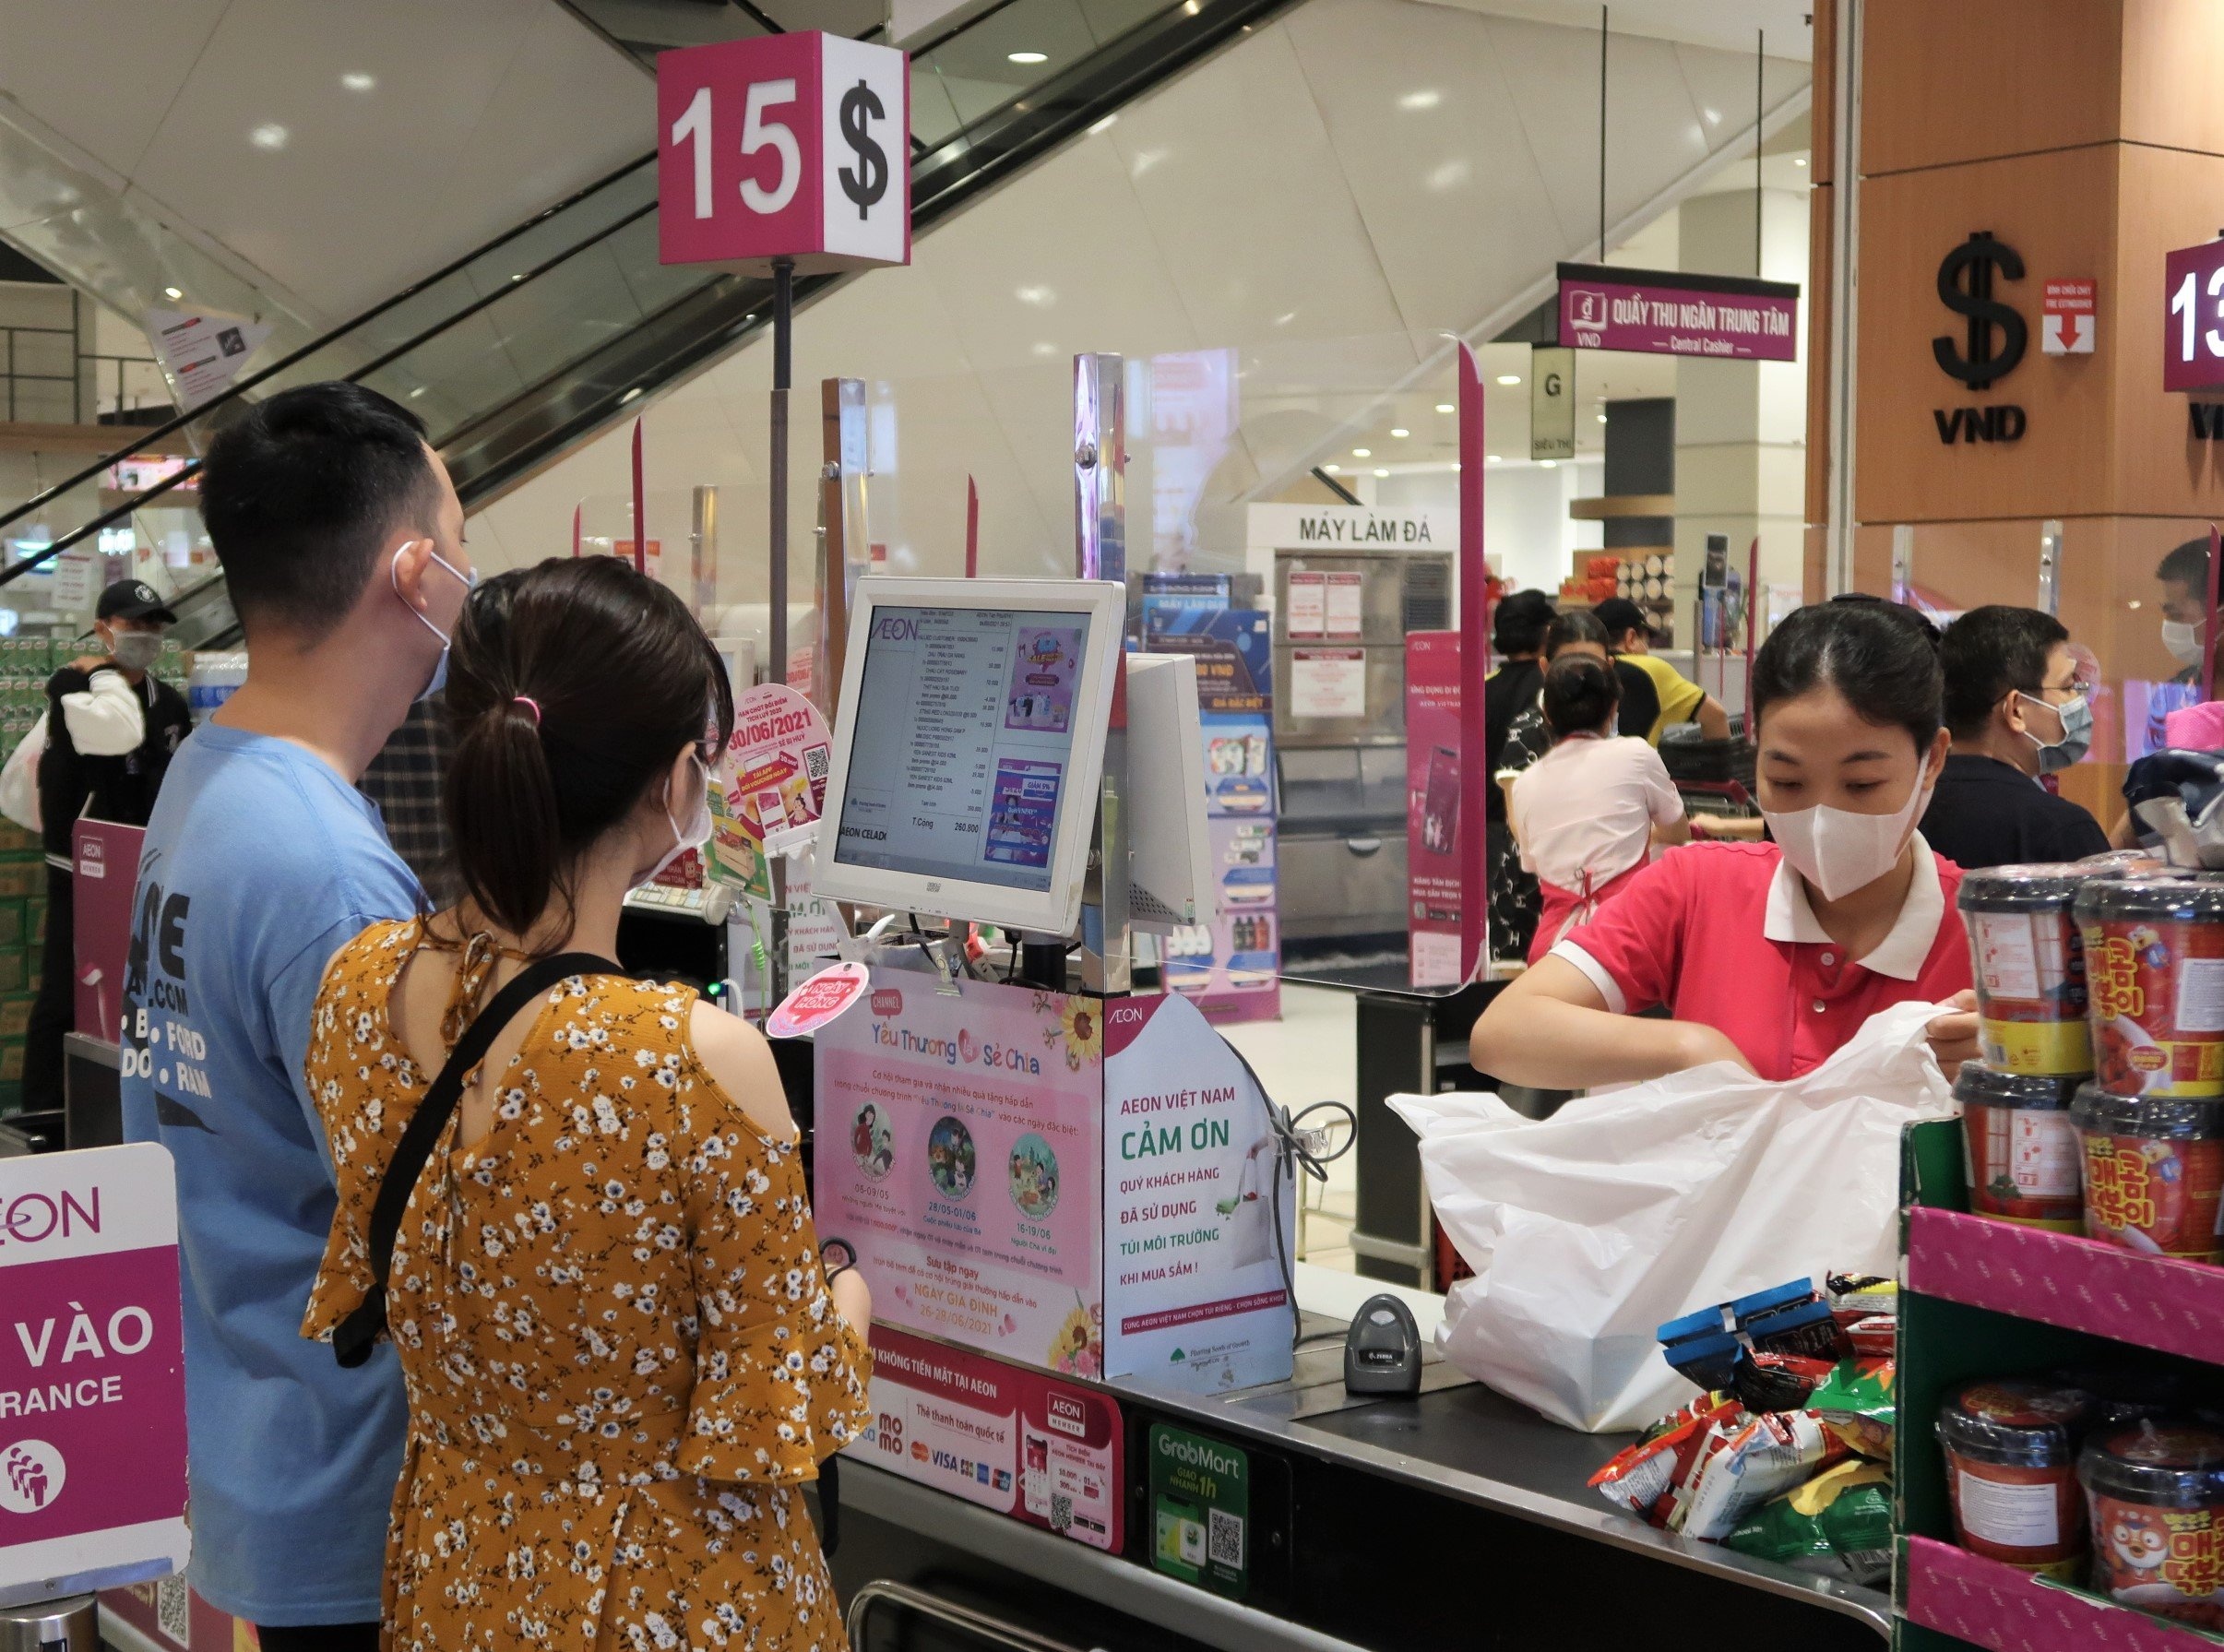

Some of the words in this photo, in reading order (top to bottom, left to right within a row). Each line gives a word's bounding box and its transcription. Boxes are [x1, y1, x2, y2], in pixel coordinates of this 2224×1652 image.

[672, 78, 801, 219] 15
[838, 79, 887, 220] $
[1652, 303, 1677, 327] THU
[1681, 301, 1716, 330] NGÂN
[1719, 306, 1760, 335] TRUNG
[1762, 306, 1790, 336] TÂM
[1577, 332, 1601, 347] VND
[1671, 336, 1701, 352] Central
[1703, 338, 1734, 354] Cashier
[1546, 374, 1561, 397] G
[1933, 405, 2027, 445] VND
[1352, 513, 1397, 541] LÀM
[729, 707, 812, 750] 30/06/2021
[841, 826, 861, 838] AEON
[83, 843, 101, 858] AEON
[873, 996, 900, 1009] CHANNEL
[166, 1021, 207, 1061] FORD
[872, 1021, 898, 1046] Yêu
[901, 1029, 957, 1065] Thương
[983, 1042, 1003, 1067] Sẻ
[1005, 1048, 1041, 1076] Chia
[176, 1062, 212, 1099] RAM
[895, 1075, 911, 1085] tham
[912, 1079, 922, 1088] gia
[1121, 1096, 1161, 1115] AEON
[1165, 1089, 1197, 1111] VIỆT
[1201, 1086, 1235, 1105] NAM
[1013, 1115, 1026, 1124] các
[1121, 1121, 1183, 1160] CẢM
[1191, 1117, 1230, 1151] ƠN
[1120, 1177, 1144, 1195] QUÝ
[1146, 1169, 1185, 1190] KHÁCH
[1187, 1167, 1220, 1183] HÀNG
[1120, 1207, 1138, 1225] ĐÃ
[1142, 1204, 1159, 1221] SỬ
[1161, 1200, 1197, 1219] DỤNG
[1017, 1222, 1051, 1240] 16-19/06
[1120, 1239, 1140, 1256] TÚI
[1143, 1235, 1168, 1252] MÔI
[1170, 1228, 1220, 1249] TRƯỜNG
[943, 1260, 957, 1275] tập
[958, 1266, 979, 1281] ngay
[1120, 1271, 1139, 1286] KHI
[1141, 1266, 1166, 1283] MUA
[1169, 1260, 1193, 1278] SẮM
[946, 1291, 967, 1309] GIA
[969, 1297, 998, 1318] ĐÌNH
[1141, 1317, 1158, 1327] AEON
[1159, 1315, 1172, 1325] VIỆT
[1172, 1313, 1187, 1321] NAM
[1187, 1310, 1204, 1319] CHỌN
[14, 1301, 153, 1368] VÀO
[878, 1349, 910, 1372] KHÔNG
[911, 1359, 932, 1378] TIỀN
[933, 1366, 953, 1386] MẶT
[954, 1373, 969, 1392] TẠI
[970, 1381, 997, 1398] AEON
[1053, 1400, 1080, 1419] AEON
[916, 1403, 931, 1418] Thẻ
[932, 1409, 955, 1427] thanh
[956, 1419, 973, 1433] toán
[975, 1425, 994, 1441] quốc
[995, 1430, 1005, 1444] tế
[1052, 1418, 1080, 1432] MEMBER
[932, 1450, 957, 1472] VISA
[1158, 1433, 1240, 1480] GrabMart
[1170, 1476, 1199, 1493] NHANH
[1177, 1467, 1196, 1480] GIAO
[1199, 1477, 1217, 1500] 1h
